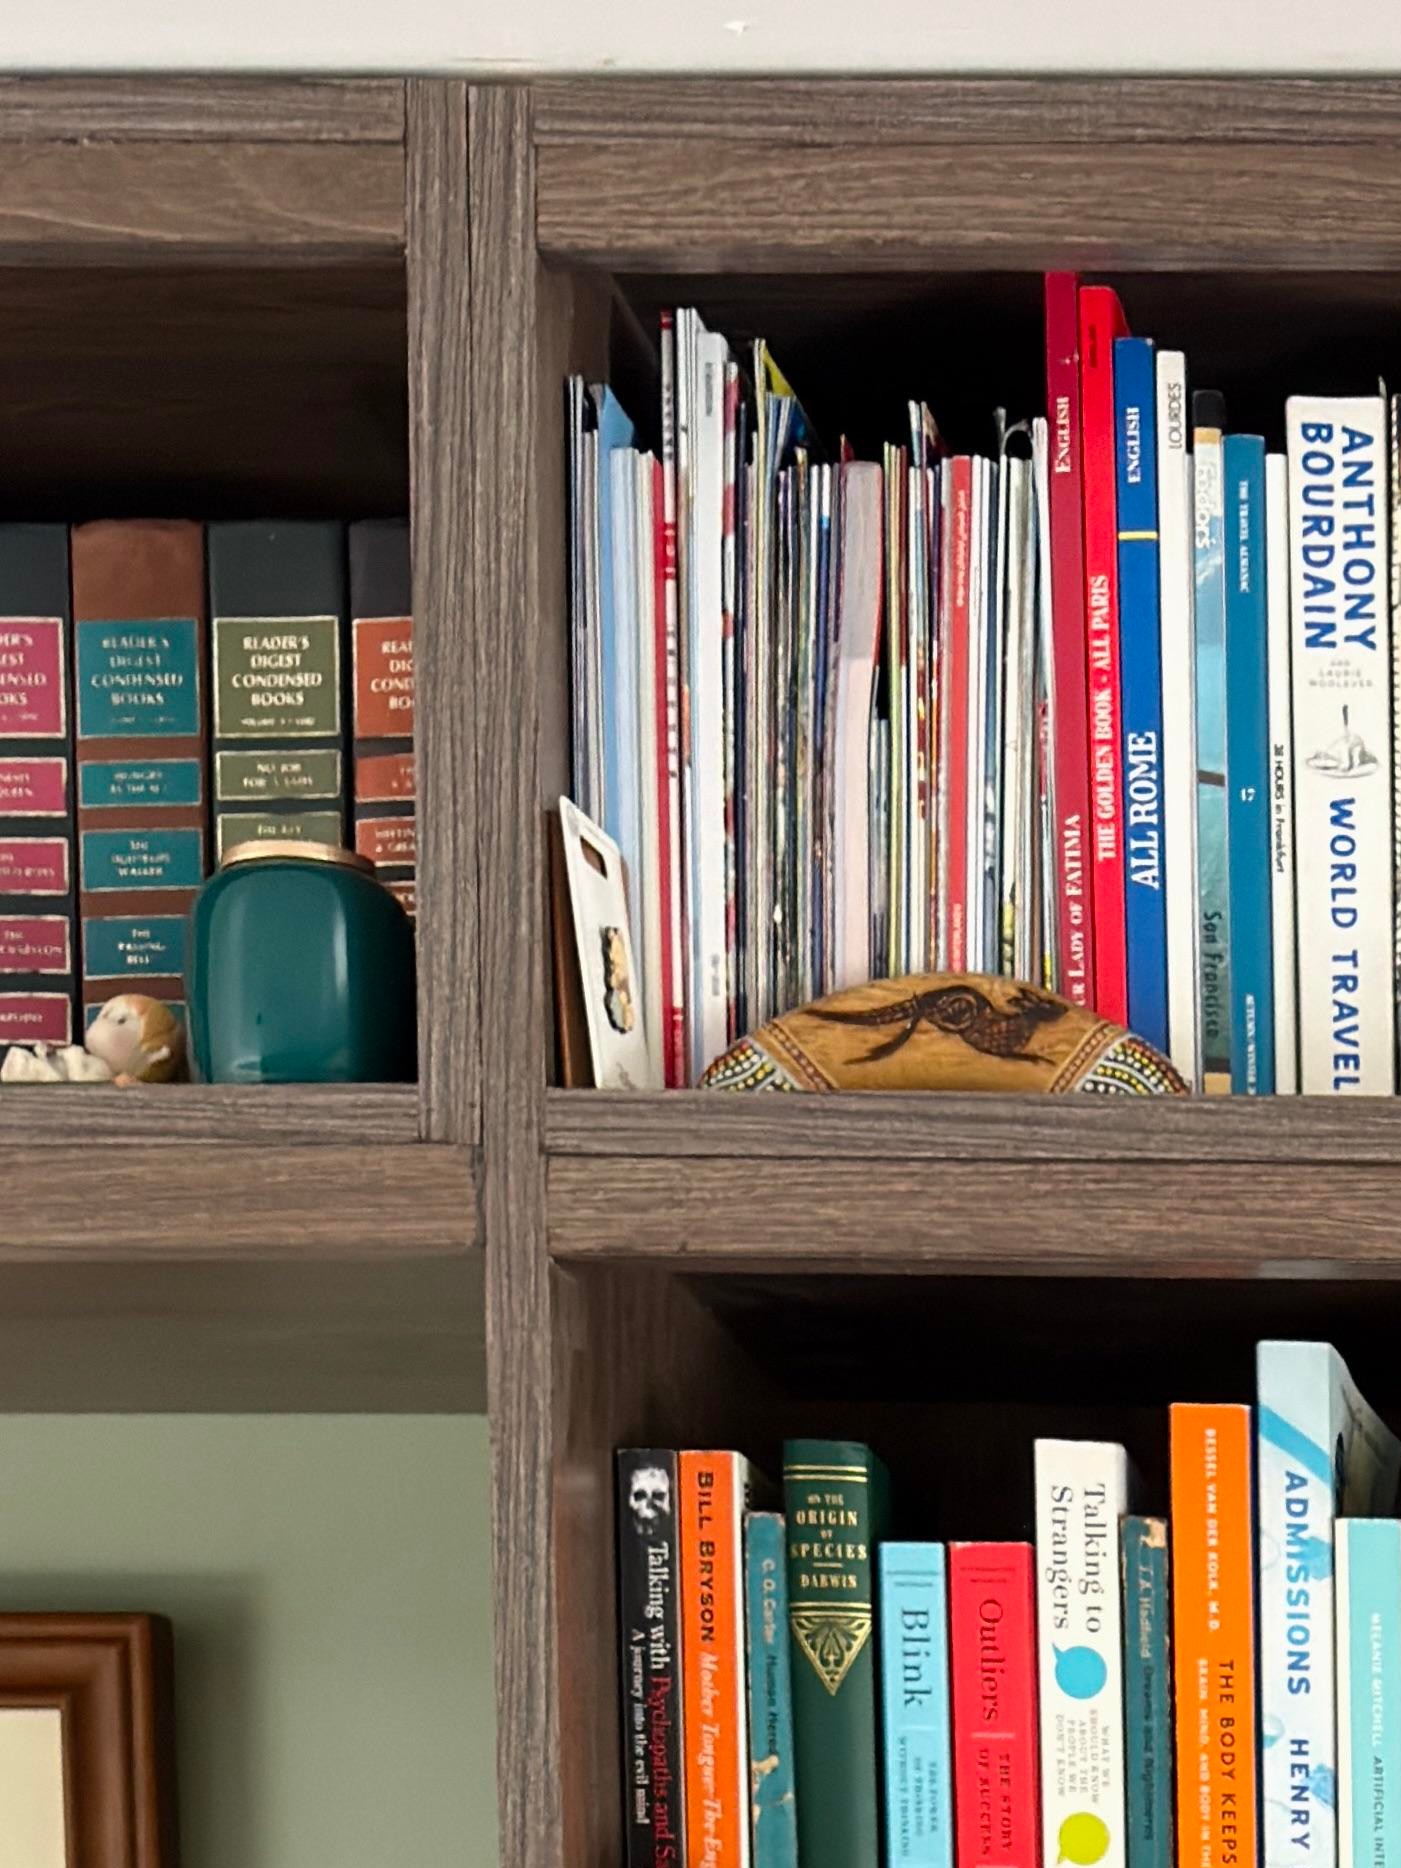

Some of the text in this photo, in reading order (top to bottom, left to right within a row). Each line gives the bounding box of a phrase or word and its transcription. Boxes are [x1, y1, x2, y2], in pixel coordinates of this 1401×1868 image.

[1300, 421, 1337, 650] BOURDAIN
[1341, 425, 1377, 652] ANTHONY
[232, 672, 322, 687] CONDENSED
[243, 637, 309, 651] READER'S
[250, 655, 301, 668] DIGEST
[251, 692, 304, 706] BOOKS
[1129, 732, 1160, 889] ALL ROME
[1329, 799, 1361, 1091] WORLD TRAVEL
[697, 1472, 716, 1642] BILL BRYSON
[1047, 1486, 1075, 1630] Strangers
[1079, 1482, 1109, 1633] Talking to
[1284, 1470, 1313, 1696] ADMISSIONS
[901, 1607, 931, 1707] Blink
[977, 1598, 1003, 1722] Outliers
[1289, 1740, 1312, 1850] HENRY
